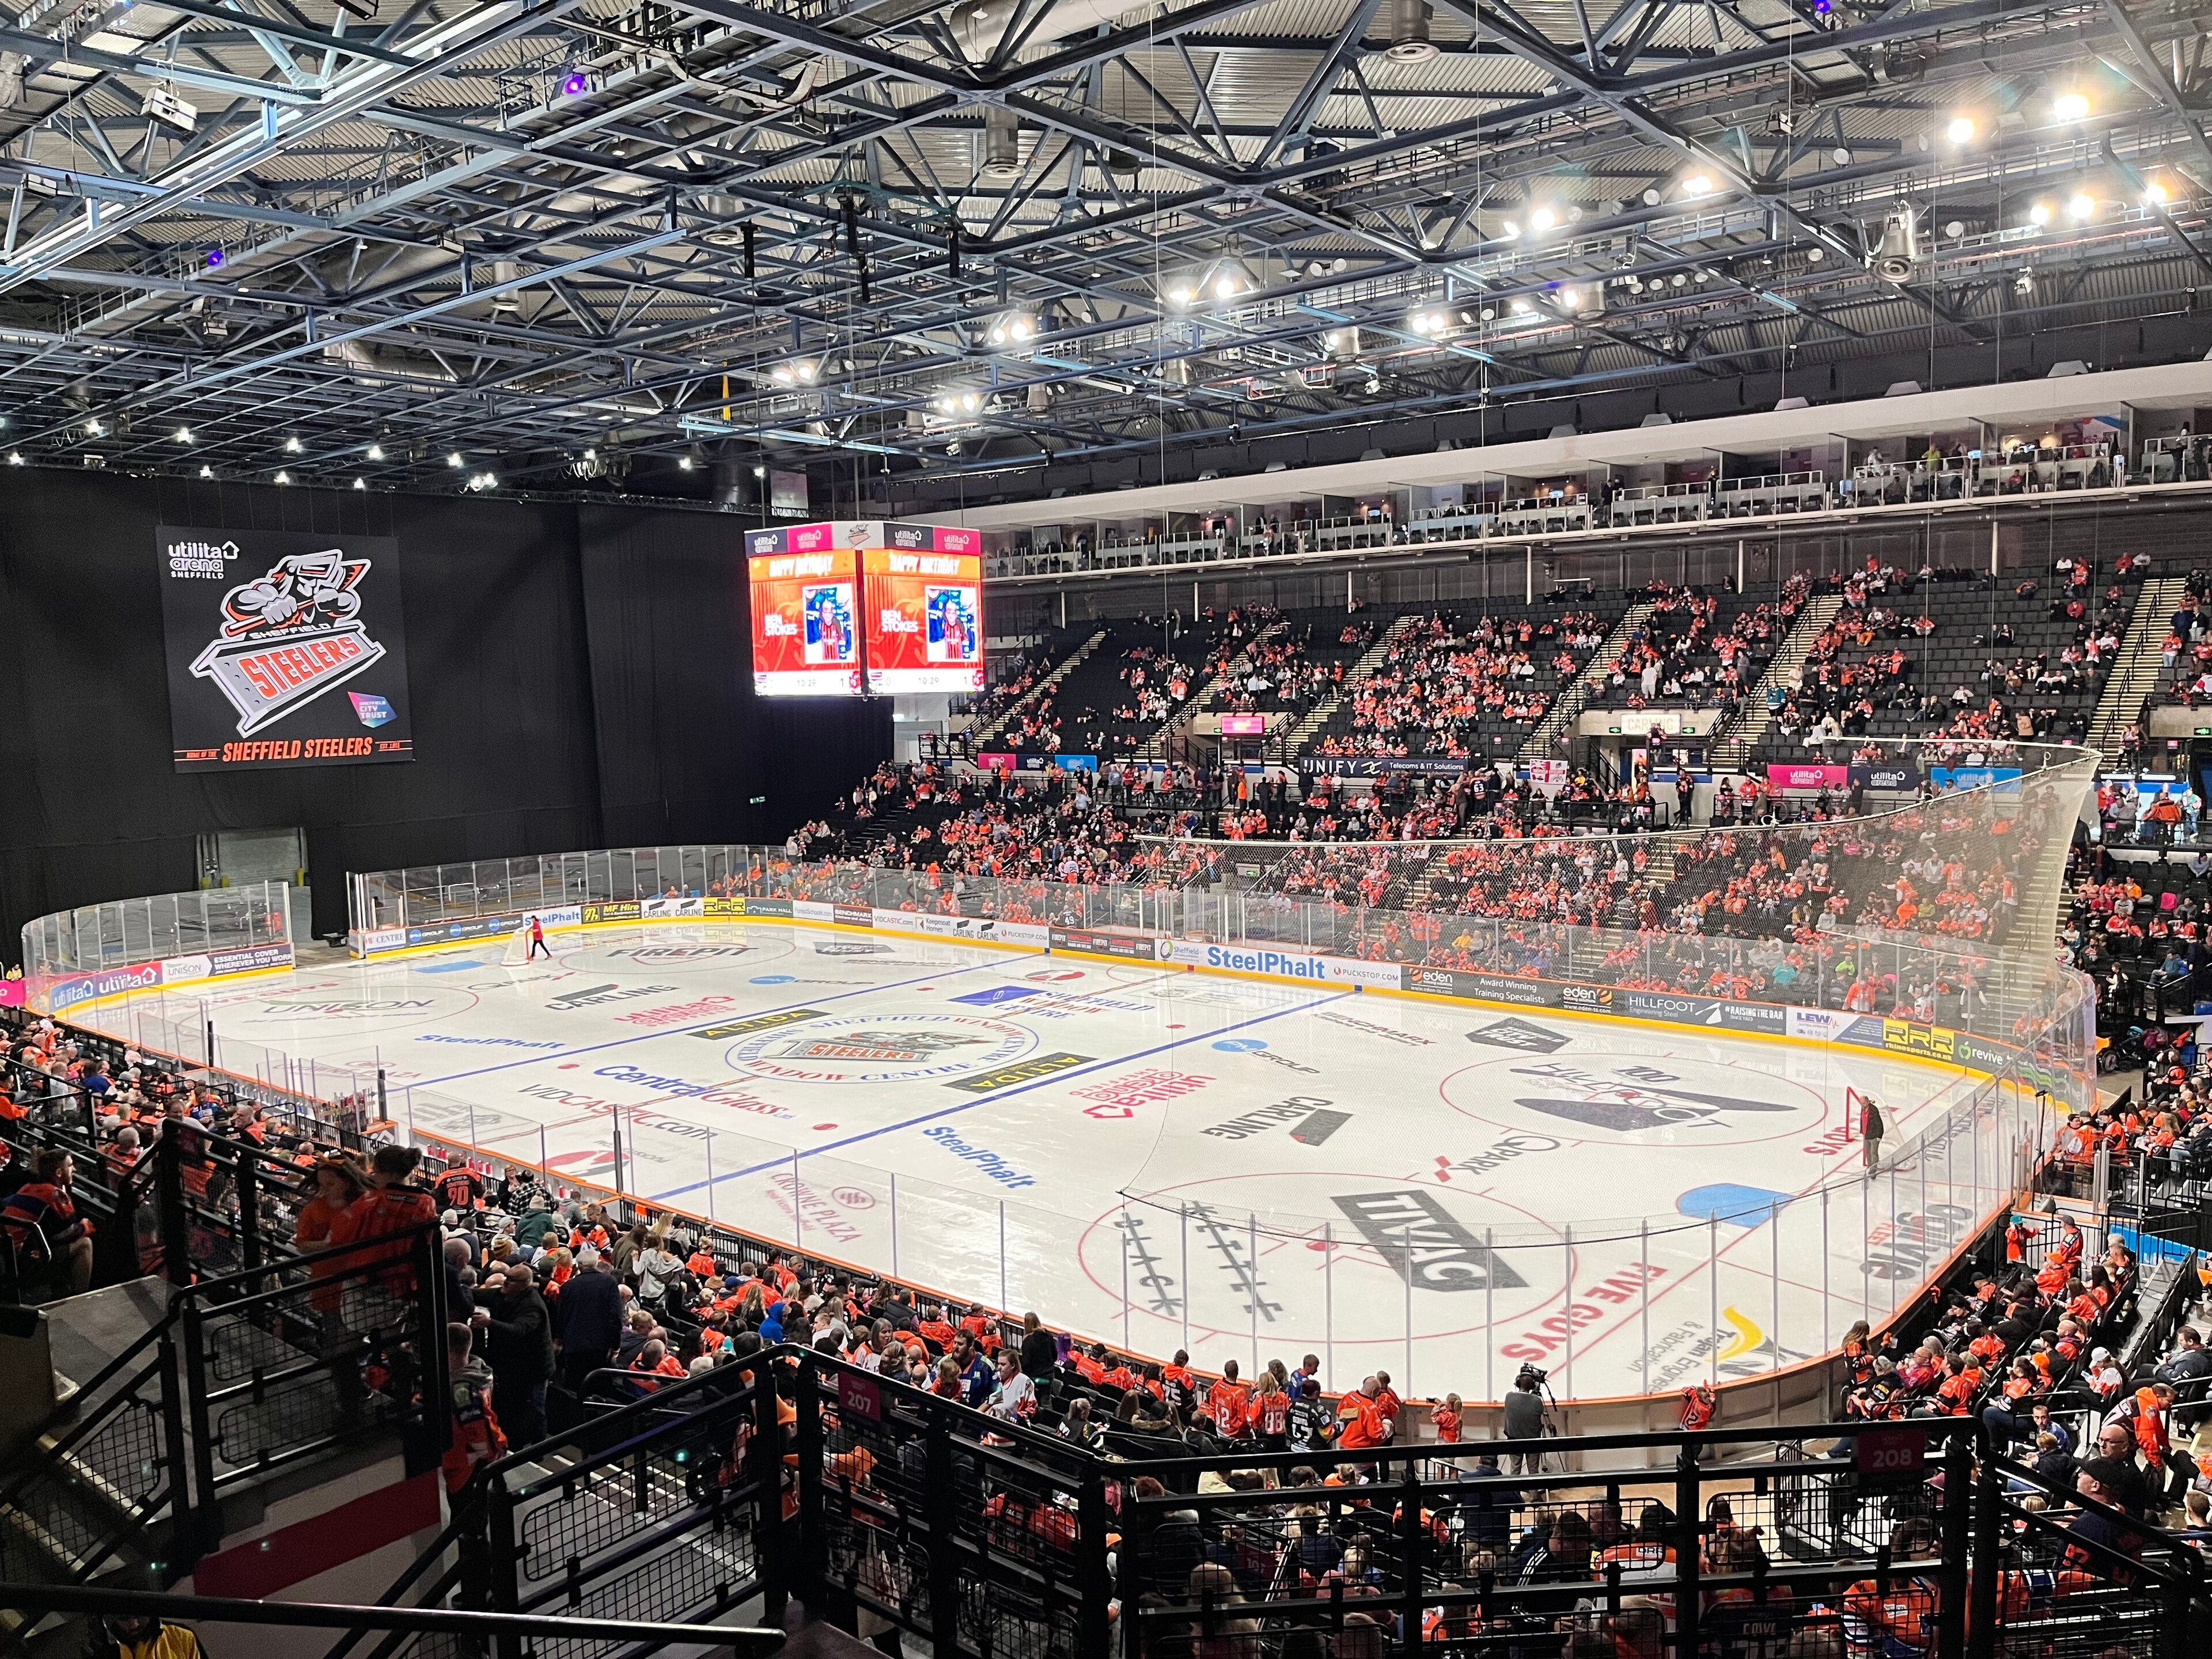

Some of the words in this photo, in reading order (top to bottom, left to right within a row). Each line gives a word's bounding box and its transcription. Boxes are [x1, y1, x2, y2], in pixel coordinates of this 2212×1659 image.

[754, 536, 772, 546] utilita
[797, 532, 815, 542] utilita
[895, 530, 915, 540] utilita
[944, 535, 964, 544] utilita
[168, 541, 222, 559] utilita
[896, 539, 916, 547] arena
[169, 558, 224, 572] arena
[769, 559, 796, 578] HAPPY
[889, 554, 920, 573] HAPPY
[171, 571, 224, 579] SHEFFIELD
[764, 614, 782, 626] BEN
[881, 609, 902, 622] BEN
[249, 623, 331, 639] SHEFFIELD
[765, 624, 797, 637] STOKES
[881, 621, 918, 632] STOKES
[237, 636, 362, 700] STEELERS
[359, 711, 387, 719] TRUST
[222, 740, 301, 762] SHEFFIELD
[304, 737, 373, 759] STEELERS
[1304, 760, 1357, 774] UNIFY
[1389, 762, 1419, 770] Telecoms
[1434, 763, 1464, 771] Solutions
[1790, 770, 1815, 778] utilita
[1870, 772, 1897, 781] utilita
[1474, 784, 1484, 793] 63
[524, 912, 580, 926] SeelPhalt
[643, 909, 671, 918] CARLING
[675, 908, 702, 916] CARLING
[835, 909, 872, 918] BENCHMARX
[874, 915, 914, 927] VIDCASTIC.com
[926, 918, 951, 931] Keepmoat
[1065, 915, 1075, 926] 49
[926, 925, 943, 933] Homes
[953, 928, 974, 940] CARLING
[977, 930, 999, 941] CARLING
[1008, 931, 1048, 941] PUCKSTOP.COM
[376, 933, 404, 944] CENTRE
[1051, 933, 1066, 942] FIREPIT
[1093, 938, 1108, 947] FIREPIT
[606, 948, 758, 957] FIREPIT
[1136, 943, 1152, 952] FIREPIT
[1173, 946, 1199, 955] Sheffield
[214, 953, 253, 964] ESSENTIAL
[254, 949, 279, 957] COVER
[214, 959, 255, 970] WHEREVER
[255, 956, 270, 964] YOU
[271, 953, 292, 962] WORK
[1208, 946, 1325, 979] SteelPhalt
[168, 964, 201, 976] UNISON
[1343, 968, 1399, 981] PUCKSTOP.COM
[1423, 970, 1453, 984] eden
[99, 974, 141, 994] utilita
[1411, 985, 1453, 995] www.eden-ts.com
[1480, 978, 1505, 988] Award
[1506, 980, 1537, 993] Winning
[54, 986, 84, 1008] utilita
[544, 984, 680, 1011] CARLING
[1474, 988, 1504, 1001] Training
[1506, 991, 1546, 1004] Specialists
[1563, 986, 1596, 1001] eden
[263, 999, 435, 1014] UNISON
[1018, 998, 1111, 1014] WINDOW
[1040, 991, 1155, 1012] SHEFFIELD
[1563, 1004, 1611, 1014] www.eden-ts.com
[1629, 996, 1696, 1012] HILLFOOT
[615, 999, 707, 1021] utilita
[993, 1002, 1076, 1020] CENTRE
[1629, 1006, 1662, 1018] Engineering
[1663, 1010, 1679, 1018] Steel
[706, 1012, 810, 1038] ALTIDA
[809, 1014, 949, 1029] SHEFFIELD
[1797, 1012, 1830, 1024] LEW
[953, 1017, 1025, 1039] WINDOW
[1321, 1012, 1437, 1044] BENCHMARX
[414, 1035, 567, 1050] SteelPhalt
[1480, 1030, 1539, 1047] TRUST
[808, 1044, 916, 1062] STEELERS
[979, 1036, 1026, 1061] CENTRE
[1885, 1043, 1952, 1061] rhinosports.co.uk
[1252, 1051, 1320, 1074] GROUP
[1972, 1048, 2003, 1066] revive
[745, 1059, 858, 1082] WINDOW
[861, 1061, 979, 1081] CENTRE
[968, 1055, 1085, 1090] ALTIDA
[1619, 1066, 1681, 1082] 100
[594, 1065, 722, 1097] Central
[700, 1091, 790, 1116] Glass
[772, 1111, 797, 1120] Ltd
[1110, 1075, 1218, 1107] utilita
[518, 1084, 718, 1141] VIDCASTIC.com
[1200, 1096, 1334, 1140] CARLING
[923, 1126, 1037, 1189] SteelPhalt
[448, 1186, 469, 1206] 90
[771, 1172, 827, 1209] CROWNE
[814, 1209, 863, 1243] PLAZA
[1357, 1194, 1487, 1281] TIVAC
[1114, 1212, 1183, 1317] BLACK
[1584, 1262, 1669, 1304] FIVE
[1501, 1303, 1604, 1362] GUYS
[1627, 1325, 1696, 1373] Fabrication
[1695, 1328, 1737, 1358] Trojan
[847, 1391, 872, 1413] 207
[1163, 1387, 1182, 1406] 75
[1266, 1412, 1284, 1431] 88
[1872, 1449, 1912, 1468] 208
